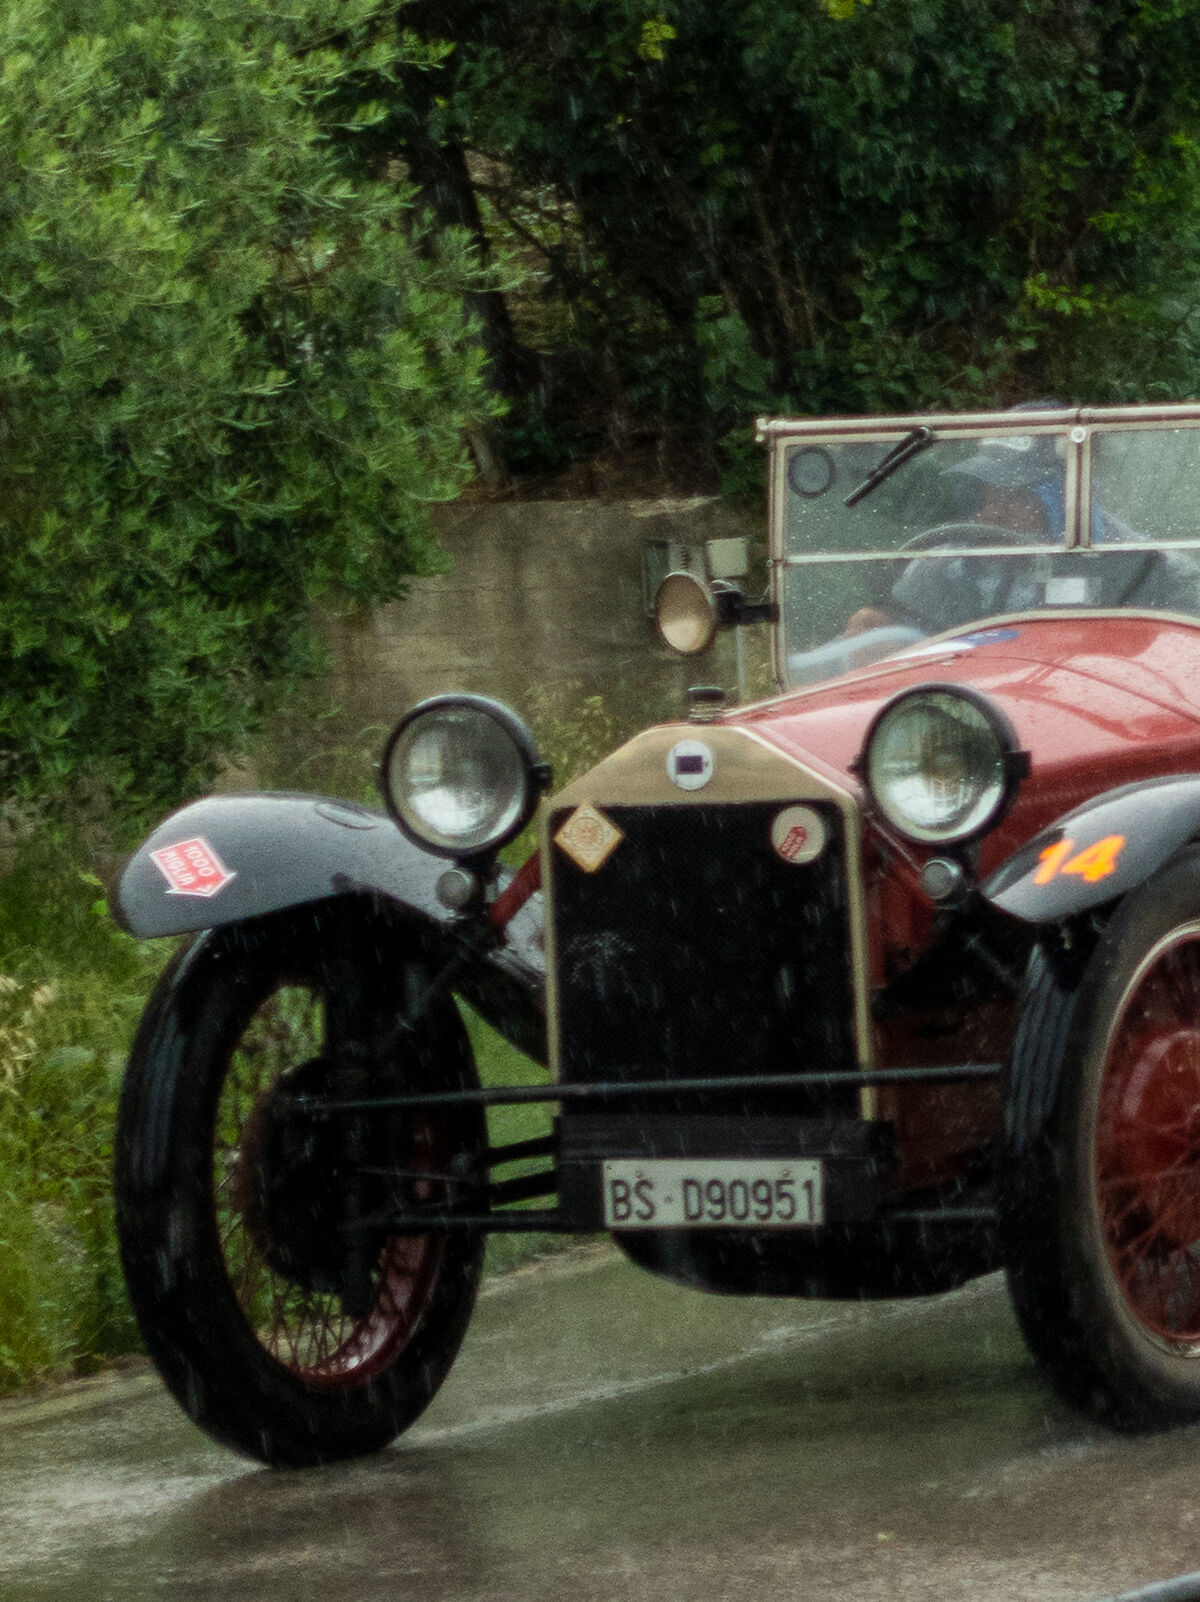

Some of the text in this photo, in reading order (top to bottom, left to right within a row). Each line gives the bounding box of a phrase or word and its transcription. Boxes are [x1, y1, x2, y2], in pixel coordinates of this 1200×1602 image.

[182, 845, 217, 877] 1000
[1033, 833, 1127, 887] 14
[610, 1178, 656, 1222] BS
